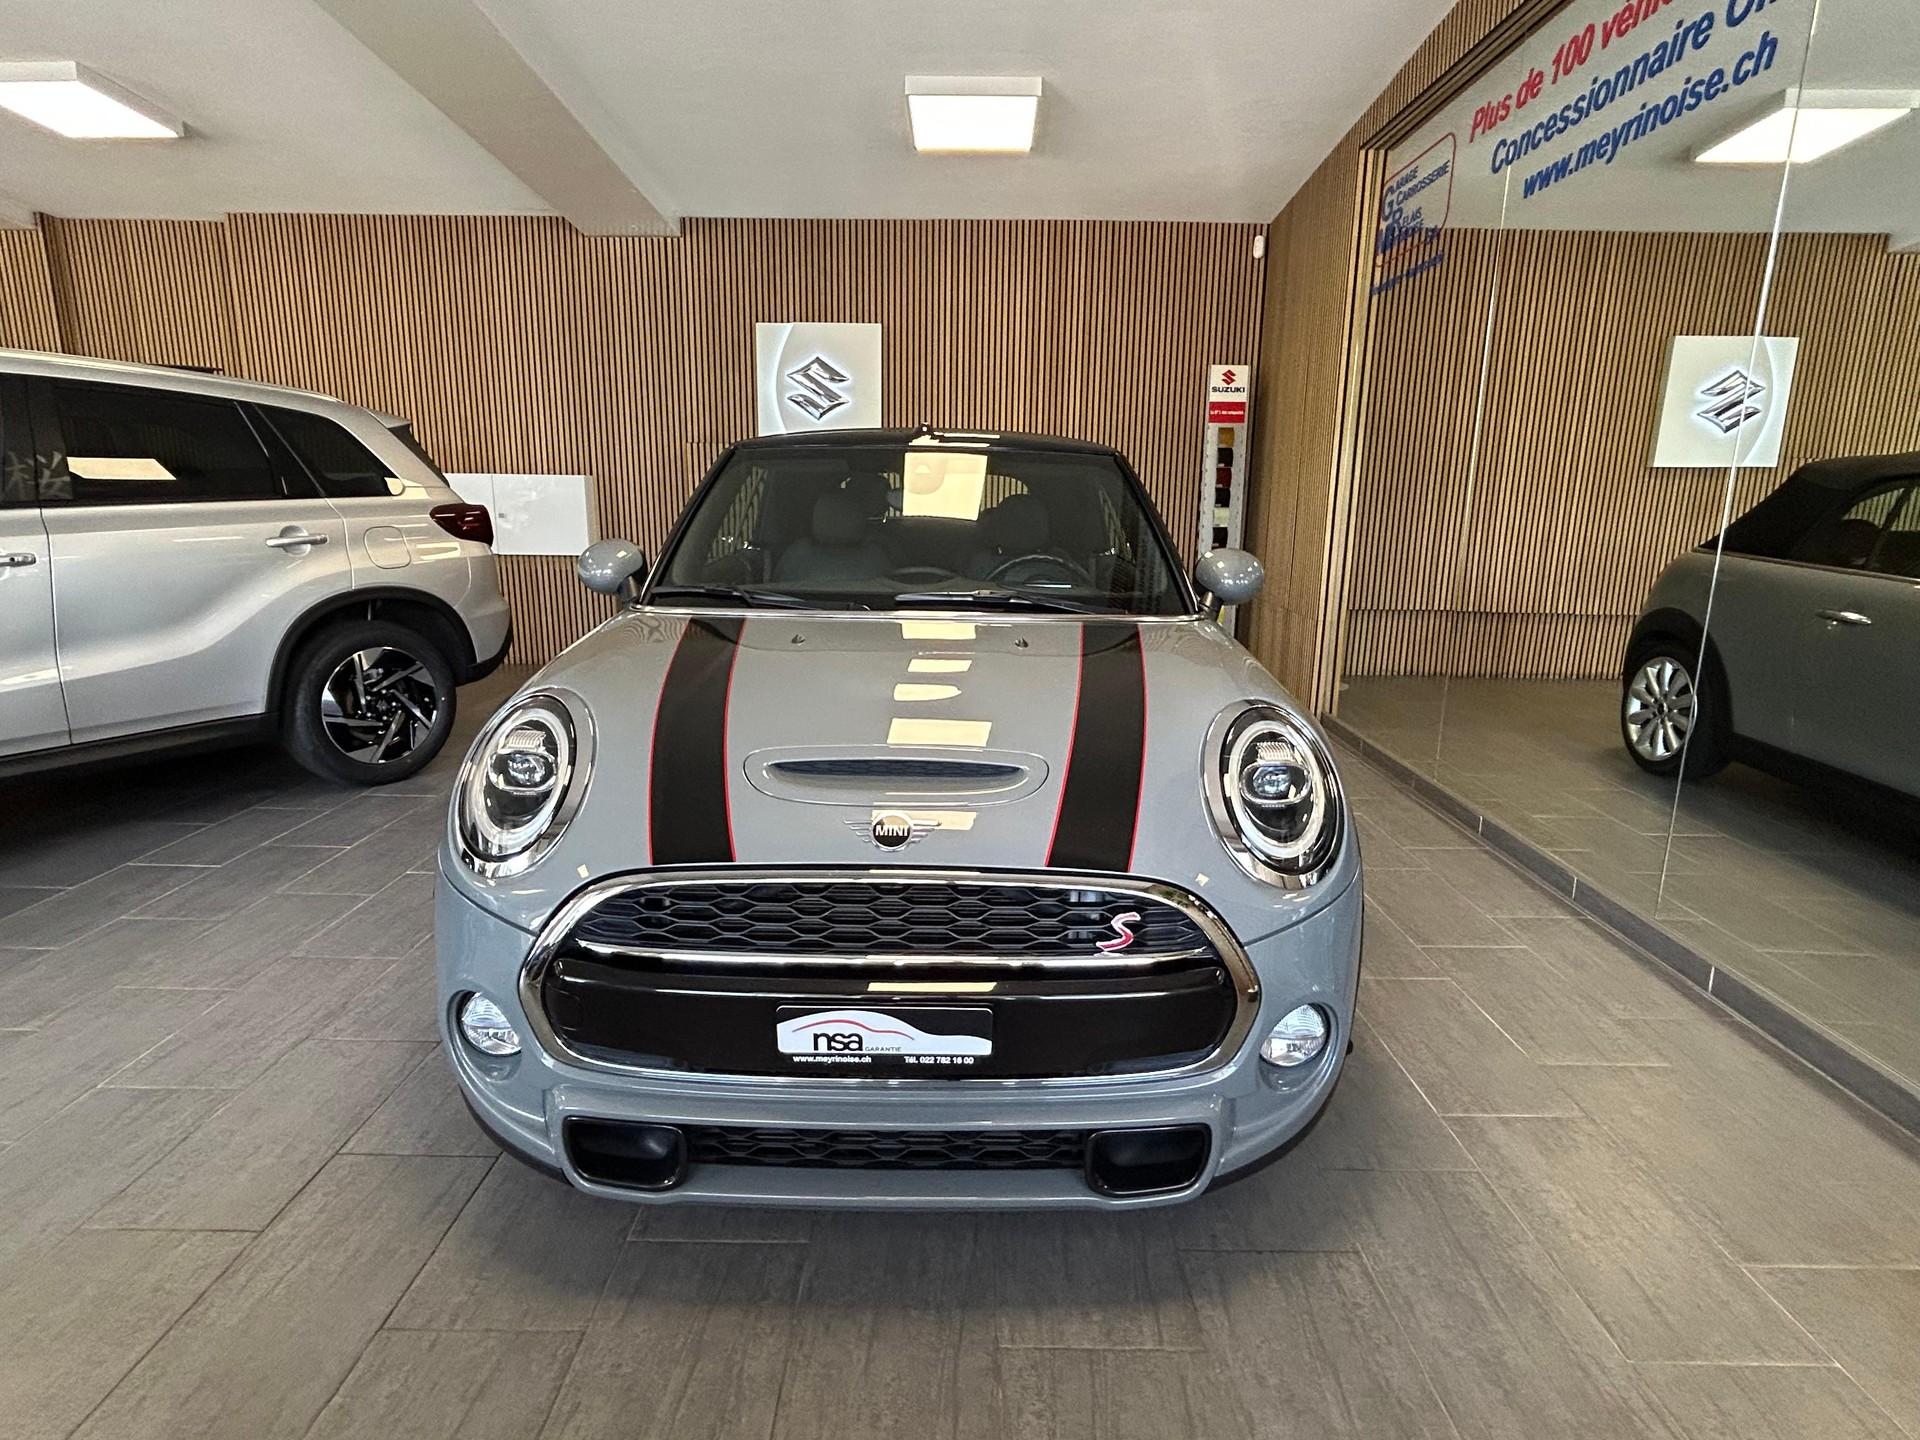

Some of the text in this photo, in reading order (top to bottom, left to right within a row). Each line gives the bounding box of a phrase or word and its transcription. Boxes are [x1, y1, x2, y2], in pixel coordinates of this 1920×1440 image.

[1470, 94, 1512, 143] Plus
[1516, 68, 1544, 109] de
[1552, 23, 1595, 84] 100
[1491, 11, 1715, 174] Concessionnaire
[1523, 30, 1778, 199] www.meyrinoise.ch
[875, 825, 910, 837] MINI
[1096, 911, 1141, 951] S
[813, 1032, 864, 1051] nsa
[792, 1055, 872, 1064] www.meyrinoise.ch
[920, 1056, 935, 1064] 022
